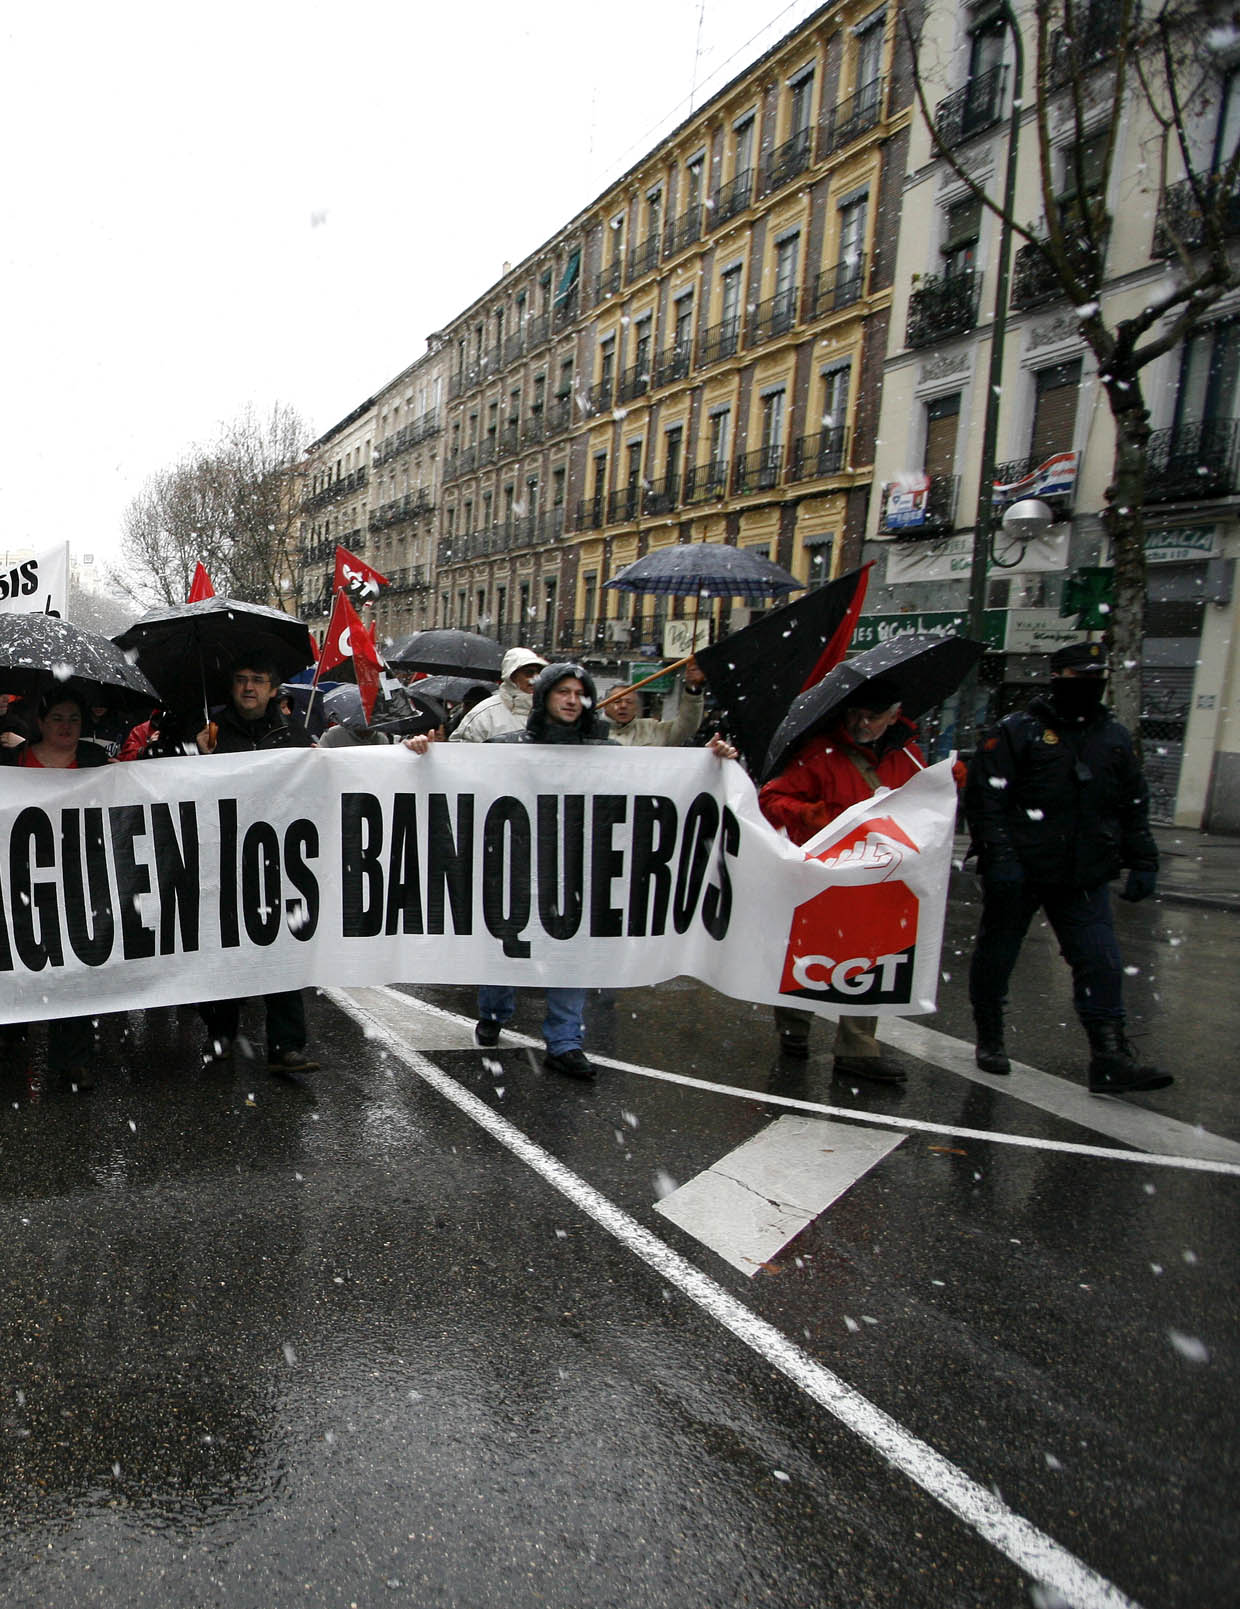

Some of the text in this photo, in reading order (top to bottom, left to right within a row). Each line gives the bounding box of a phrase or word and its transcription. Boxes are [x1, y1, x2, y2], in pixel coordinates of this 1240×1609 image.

[852, 626, 873, 646] JES
[218, 798, 320, 948] los
[341, 792, 741, 959] BANQUEROS
[792, 953, 909, 995] CGT
